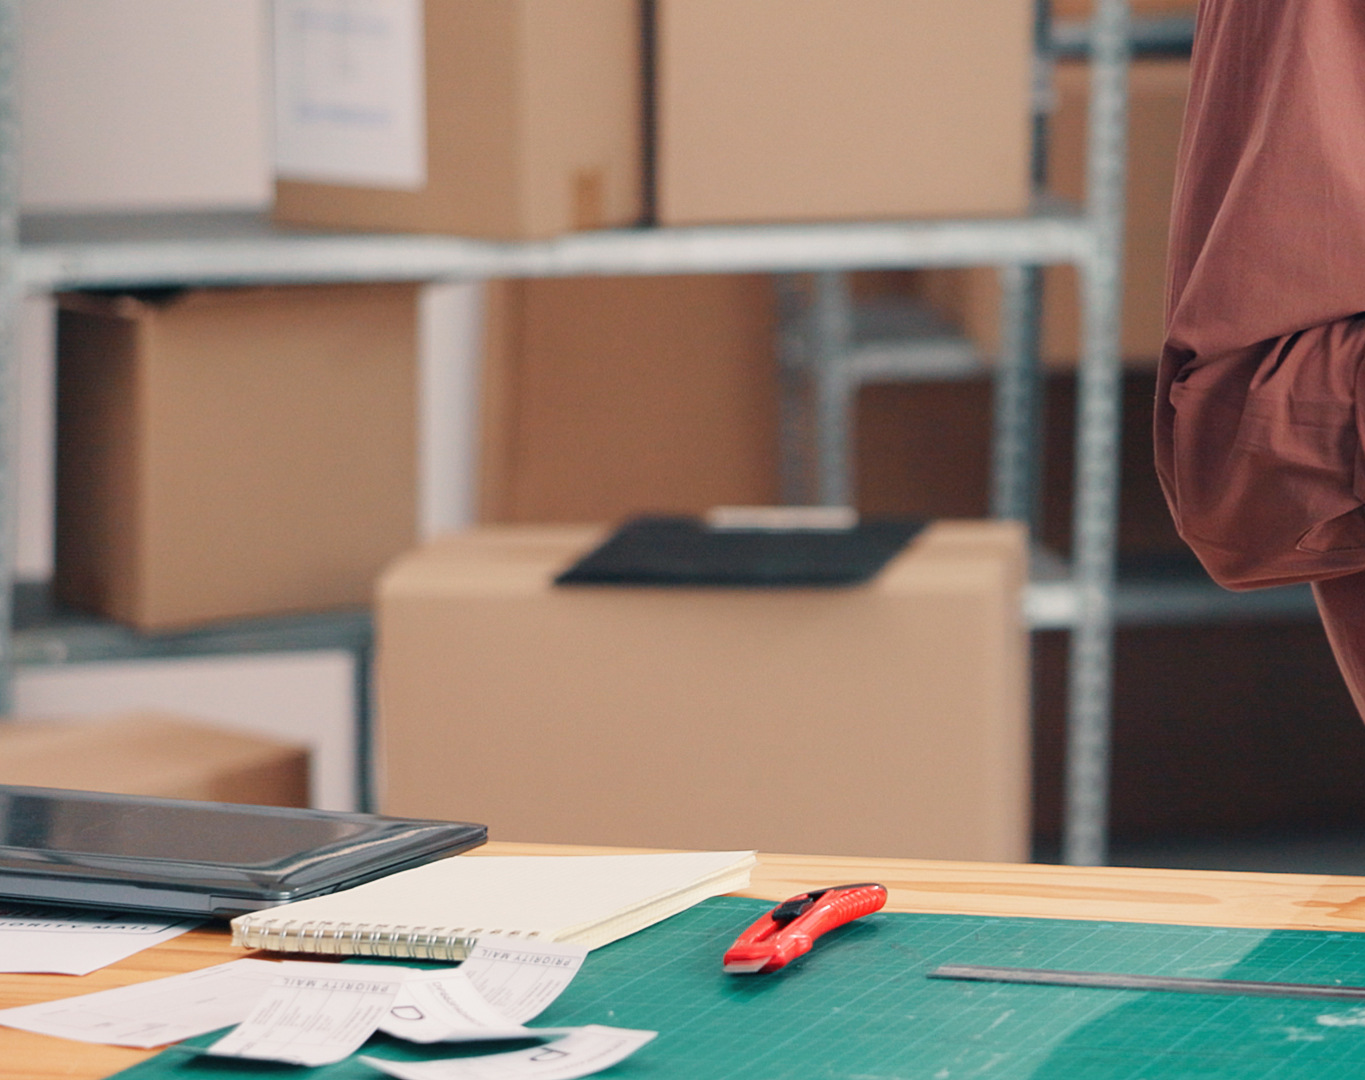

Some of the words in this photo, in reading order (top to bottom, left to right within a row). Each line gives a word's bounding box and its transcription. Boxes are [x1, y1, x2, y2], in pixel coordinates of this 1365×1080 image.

[481, 949, 509, 960] MAIL
[515, 953, 571, 967] PRIORITY
[283, 977, 316, 987] MAIL
[321, 982, 390, 993] PRIORITY
